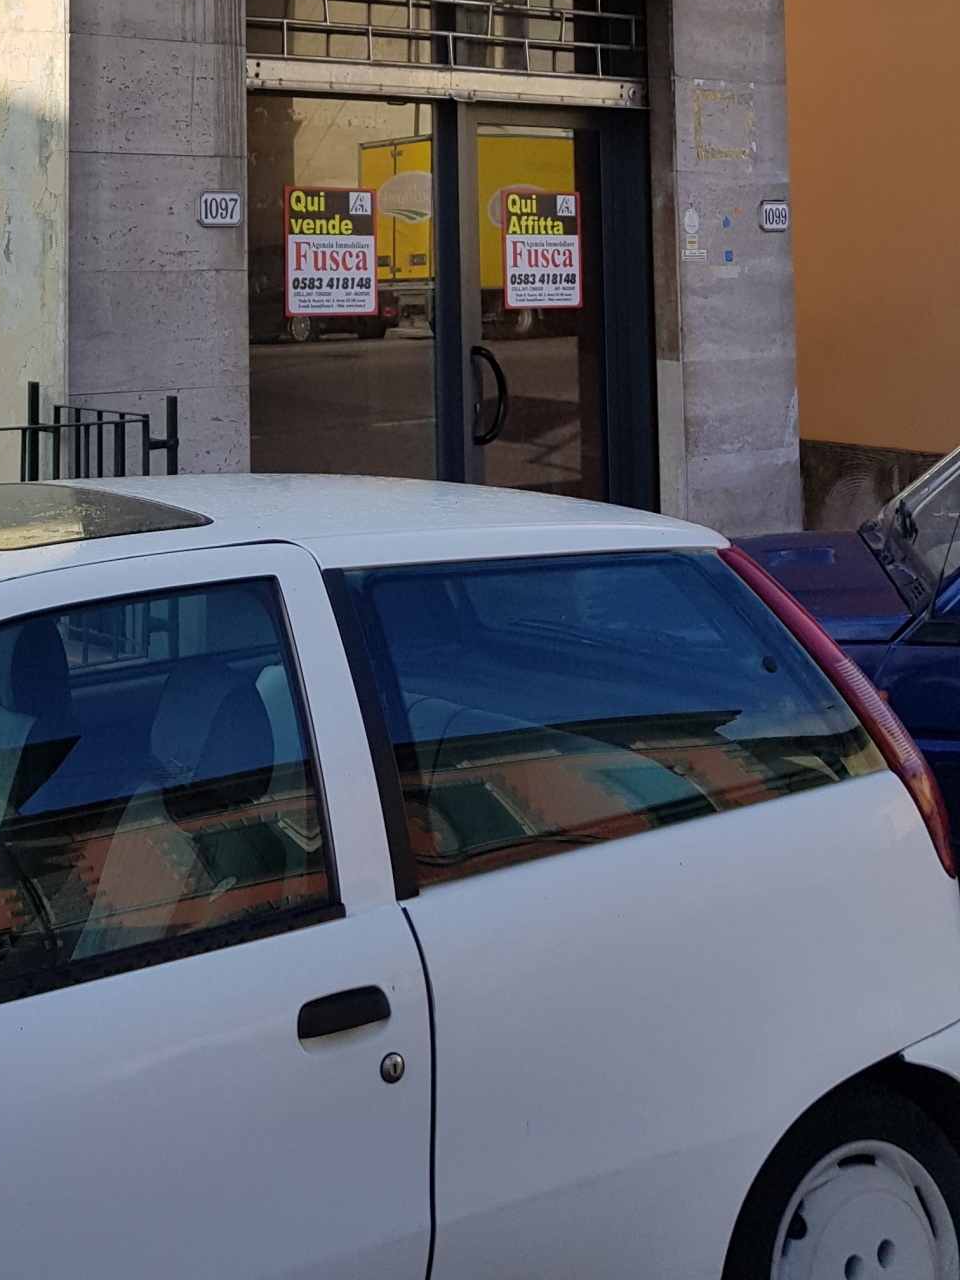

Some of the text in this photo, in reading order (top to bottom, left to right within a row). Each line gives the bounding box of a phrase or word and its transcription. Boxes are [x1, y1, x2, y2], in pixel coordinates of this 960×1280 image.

[203, 197, 238, 220] 1097
[290, 190, 326, 213] Qui
[507, 194, 537, 214] Qui
[290, 214, 353, 234] vende
[508, 215, 564, 234] Affitta
[764, 207, 787, 225] 1099
[292, 241, 369, 272] Fusca
[510, 240, 574, 269] Fusca
[292, 277, 372, 290] 0583 418148
[510, 273, 577, 285] 0583 418148
